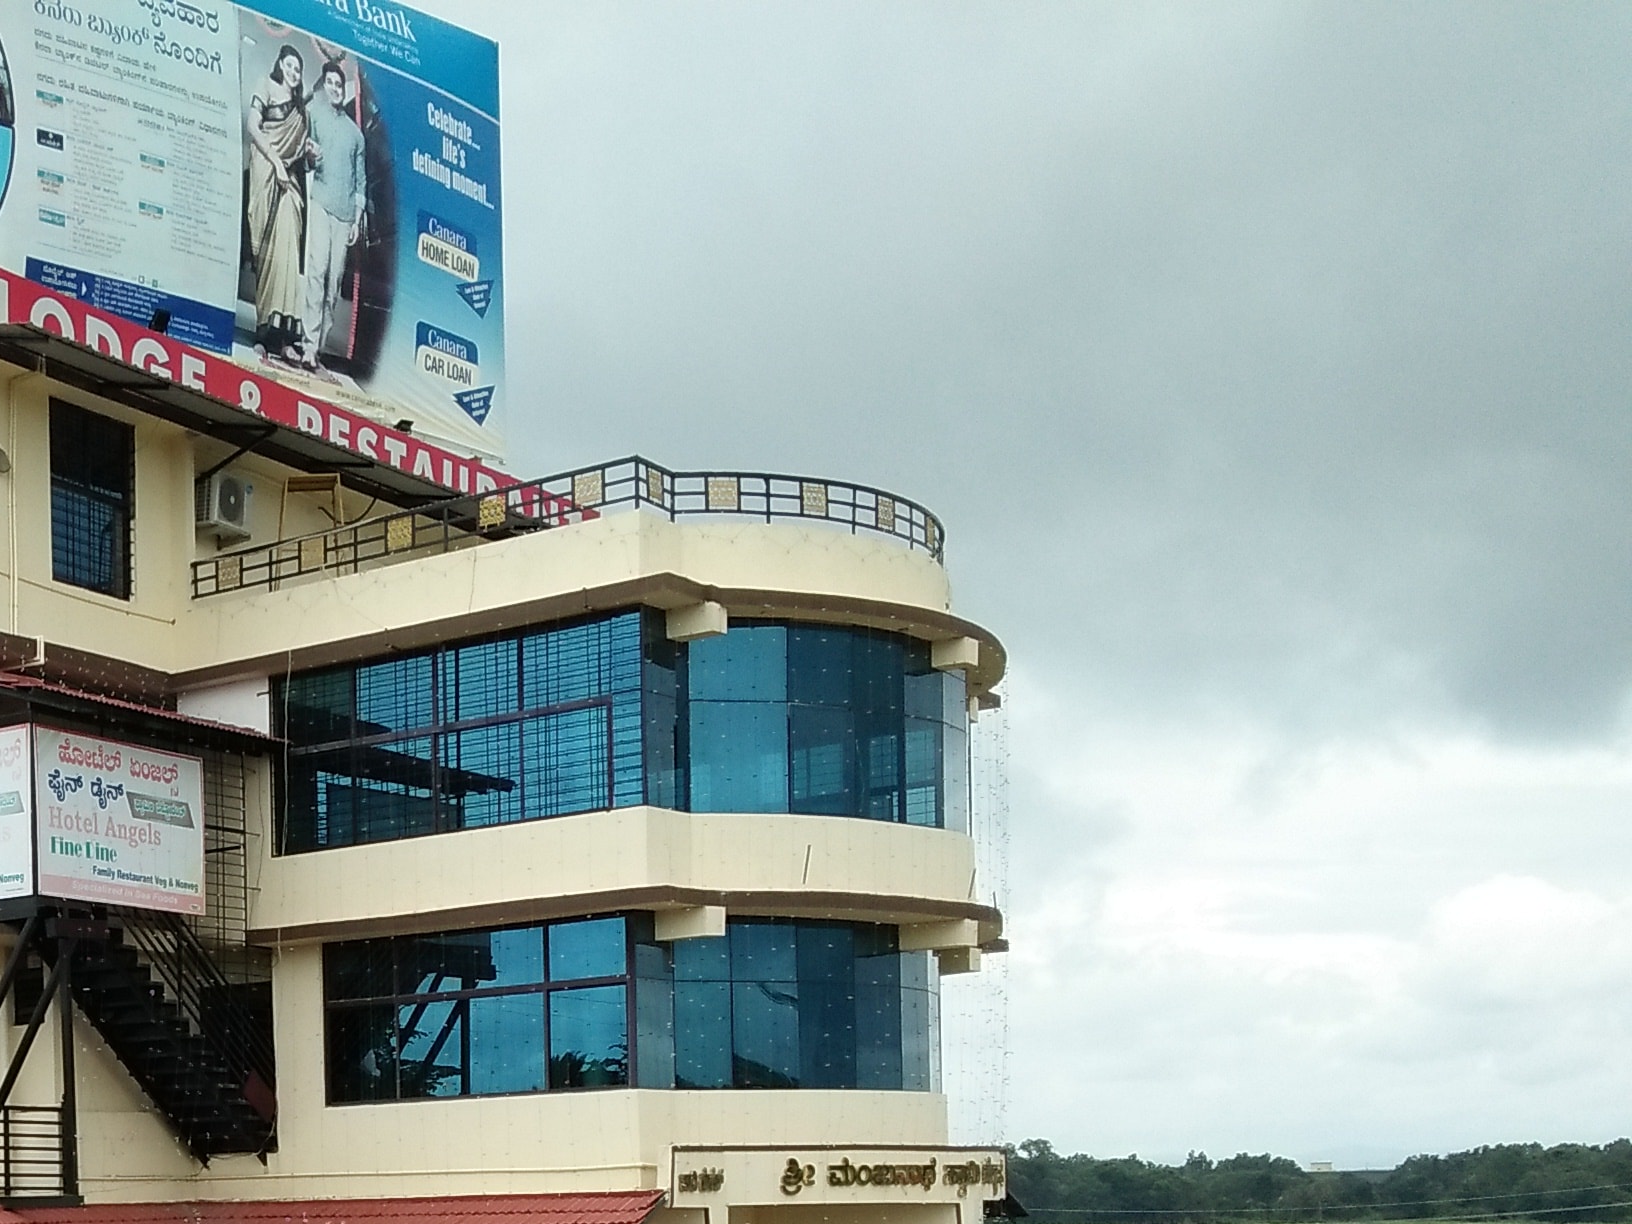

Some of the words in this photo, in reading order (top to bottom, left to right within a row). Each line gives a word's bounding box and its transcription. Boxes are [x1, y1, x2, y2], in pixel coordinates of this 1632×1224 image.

[355, 0, 416, 42] Bank
[412, 149, 452, 190] defining
[428, 217, 467, 250] Canara
[421, 239, 450, 268] HOME
[451, 255, 475, 280] LOAN
[428, 329, 467, 360] Canara
[424, 353, 445, 377] CAR
[447, 365, 472, 386] LOAN
[48, 806, 99, 835] Hotel
[105, 815, 161, 848] Angels
[51, 836, 83, 858] Fine
[85, 841, 118, 863] Dine
[92, 865, 116, 881] Family
[116, 869, 154, 885] Restaurant
[155, 876, 168, 889] Veg
[168, 878, 174, 888] &
[175, 879, 199, 894] Nonveg
[780, 1157, 816, 1196] ಶ್ರೀ
